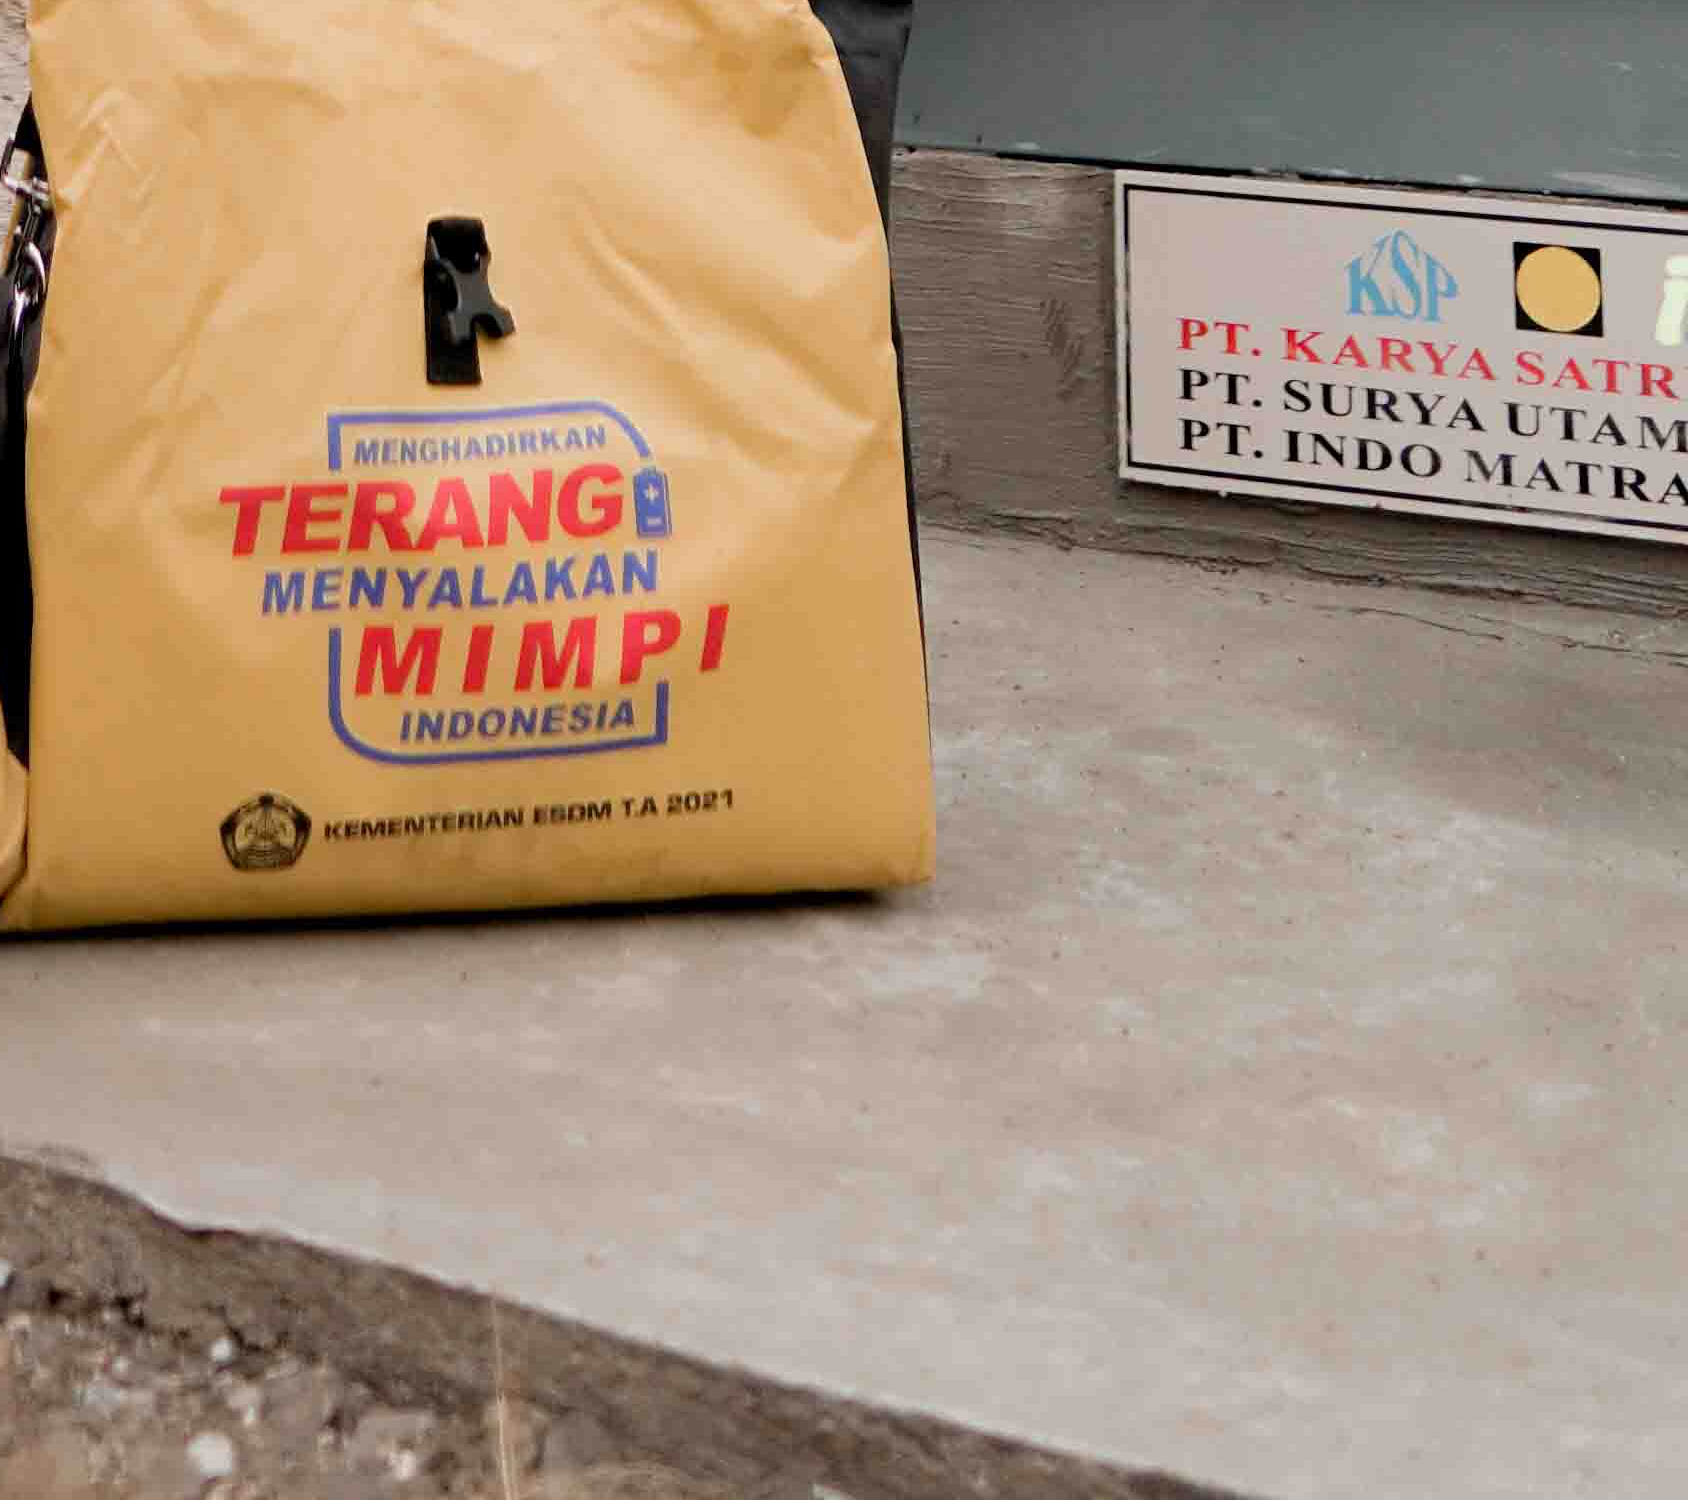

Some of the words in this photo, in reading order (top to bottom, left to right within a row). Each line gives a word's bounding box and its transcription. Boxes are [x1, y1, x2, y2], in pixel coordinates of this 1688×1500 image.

[1344, 229, 1459, 322] KSP
[1177, 317, 1261, 357] PT.
[1281, 328, 1497, 381] KARYA
[1515, 350, 1688, 400] SATR
[1178, 368, 1263, 408] PT.
[1283, 379, 1487, 432] SURYA
[353, 425, 608, 465] MENGHADIRKAN
[1179, 419, 1264, 460] PT.
[1285, 430, 1441, 478] INDO
[1464, 450, 1688, 507] MATRA
[218, 463, 625, 557] TERANG
[261, 549, 659, 617] MENYALAKAN
[354, 603, 730, 697] MIMPI
[400, 698, 637, 744] INDONESIA
[324, 808, 524, 840] KEMENTERIAN
[533, 800, 613, 825] ESDM
[666, 788, 735, 812] 2021
